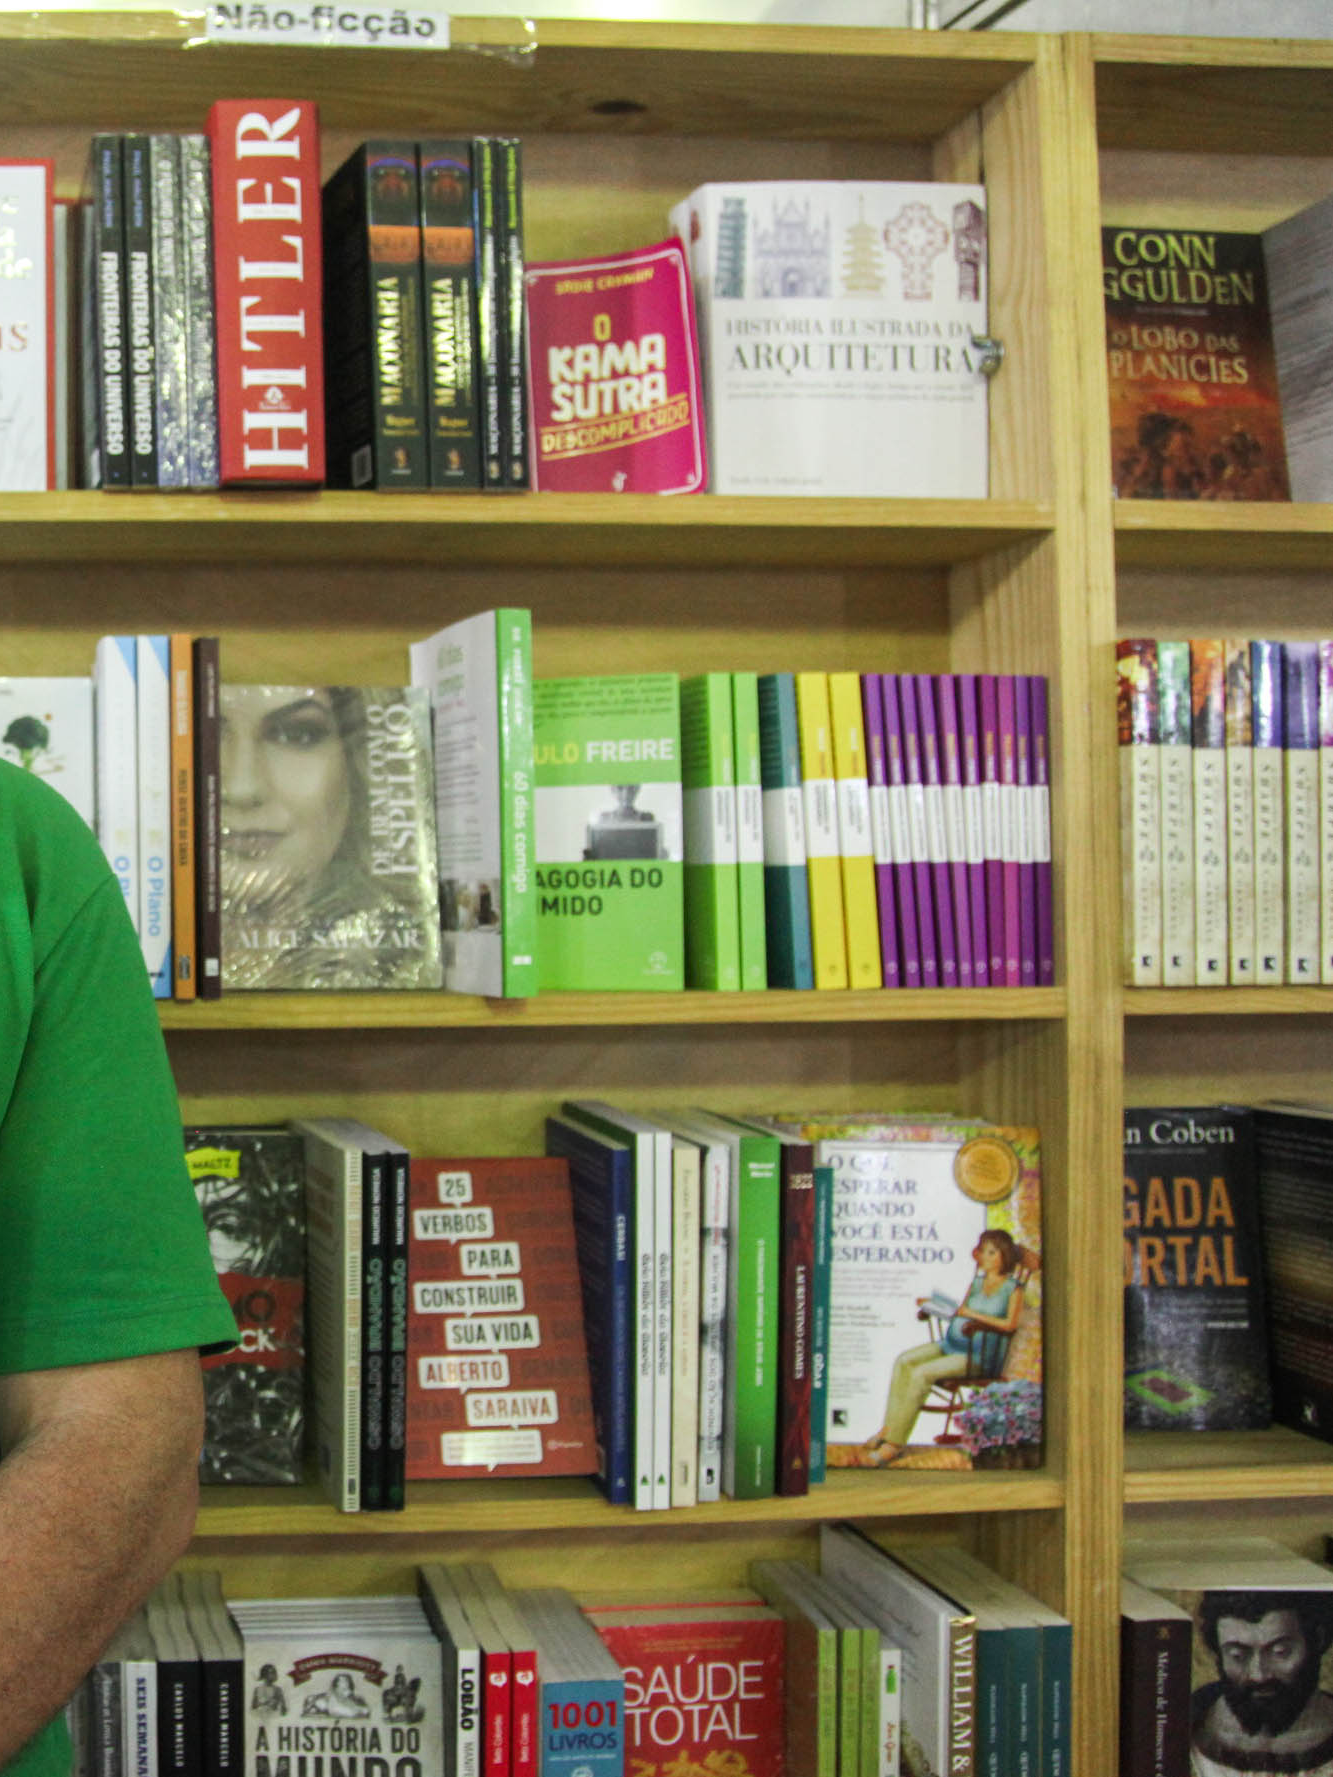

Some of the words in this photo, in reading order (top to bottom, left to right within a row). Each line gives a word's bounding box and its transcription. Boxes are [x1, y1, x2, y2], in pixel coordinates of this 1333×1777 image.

[214, 4, 437, 41] Não-ficção
[1114, 231, 1217, 270] CONN
[101, 251, 120, 348] FRONTEIRAS
[130, 251, 150, 348] FRONTEIRAS
[234, 107, 309, 471] HITLER
[1103, 267, 1255, 305] GGULDEN
[593, 314, 612, 341] O
[725, 314, 824, 336] HISTÓRIA
[830, 318, 943, 337] ILUSTRADA
[947, 319, 975, 337] DA
[1130, 325, 1199, 352] LOBO
[103, 350, 122, 373] DO
[132, 350, 152, 373] DO
[548, 333, 667, 385] KAMA
[727, 343, 976, 377] ARQUITETURA
[104, 374, 124, 455] UNIVERSO
[134, 374, 154, 455] UNIVERSO
[550, 371, 668, 423] SUTRA
[541, 399, 690, 454] DESCOMPLICADO
[534, 743, 580, 765] ULO
[586, 737, 676, 764] FREIRE
[385, 703, 419, 875] ESPELHO
[512, 771, 527, 792] 60
[513, 796, 528, 828] dias
[147, 856, 164, 873] O
[512, 833, 529, 894] comigo
[535, 868, 623, 890] AGOGIA
[630, 868, 663, 890] DO
[147, 878, 166, 938] Plano
[235, 930, 304, 949] ALICE
[312, 930, 423, 949] SALAZAR
[1150, 1119, 1236, 1145] Coben
[828, 1154, 844, 1170] O
[444, 1177, 467, 1197] 25
[1123, 1177, 1235, 1229] GADA
[419, 1212, 488, 1235] VERBOS
[890, 1221, 939, 1241] ESTÁ
[467, 1247, 515, 1269] PARA
[833, 1247, 955, 1265] ESPERANDO
[1123, 1234, 1250, 1287] RTAL
[367, 1259, 383, 1352] BRANDÃO
[390, 1259, 406, 1352] BRANDÃO
[420, 1284, 518, 1309] CONSTRUIR
[794, 1265, 805, 1337] LAURENTINO
[452, 1324, 487, 1345] SUA
[492, 1321, 534, 1343] VIDA
[425, 1360, 503, 1382] ALBERTO
[794, 1338, 805, 1379] GOMES
[472, 1397, 553, 1420] SARAIVA
[136, 1677, 148, 1710] SEIS
[460, 1668, 479, 1731] LOBÃO
[621, 1654, 765, 1708] SAÚDE
[952, 1633, 972, 1749] WILLIAM
[174, 1683, 183, 1720] CARLOS
[219, 1683, 229, 1720] CARLOS
[548, 1701, 617, 1730] 1001
[255, 1726, 269, 1752] A
[278, 1719, 381, 1753] HISTÓRIA
[391, 1727, 421, 1754] DO
[548, 1731, 617, 1751] LIVROS
[624, 1702, 759, 1747] TOTAL
[1155, 1713, 1169, 1761] Homens
[137, 1713, 149, 1777] SEMANA
[174, 1722, 183, 1768] MARCELO
[219, 1722, 229, 1768] MARCELO
[952, 1754, 972, 1771] &
